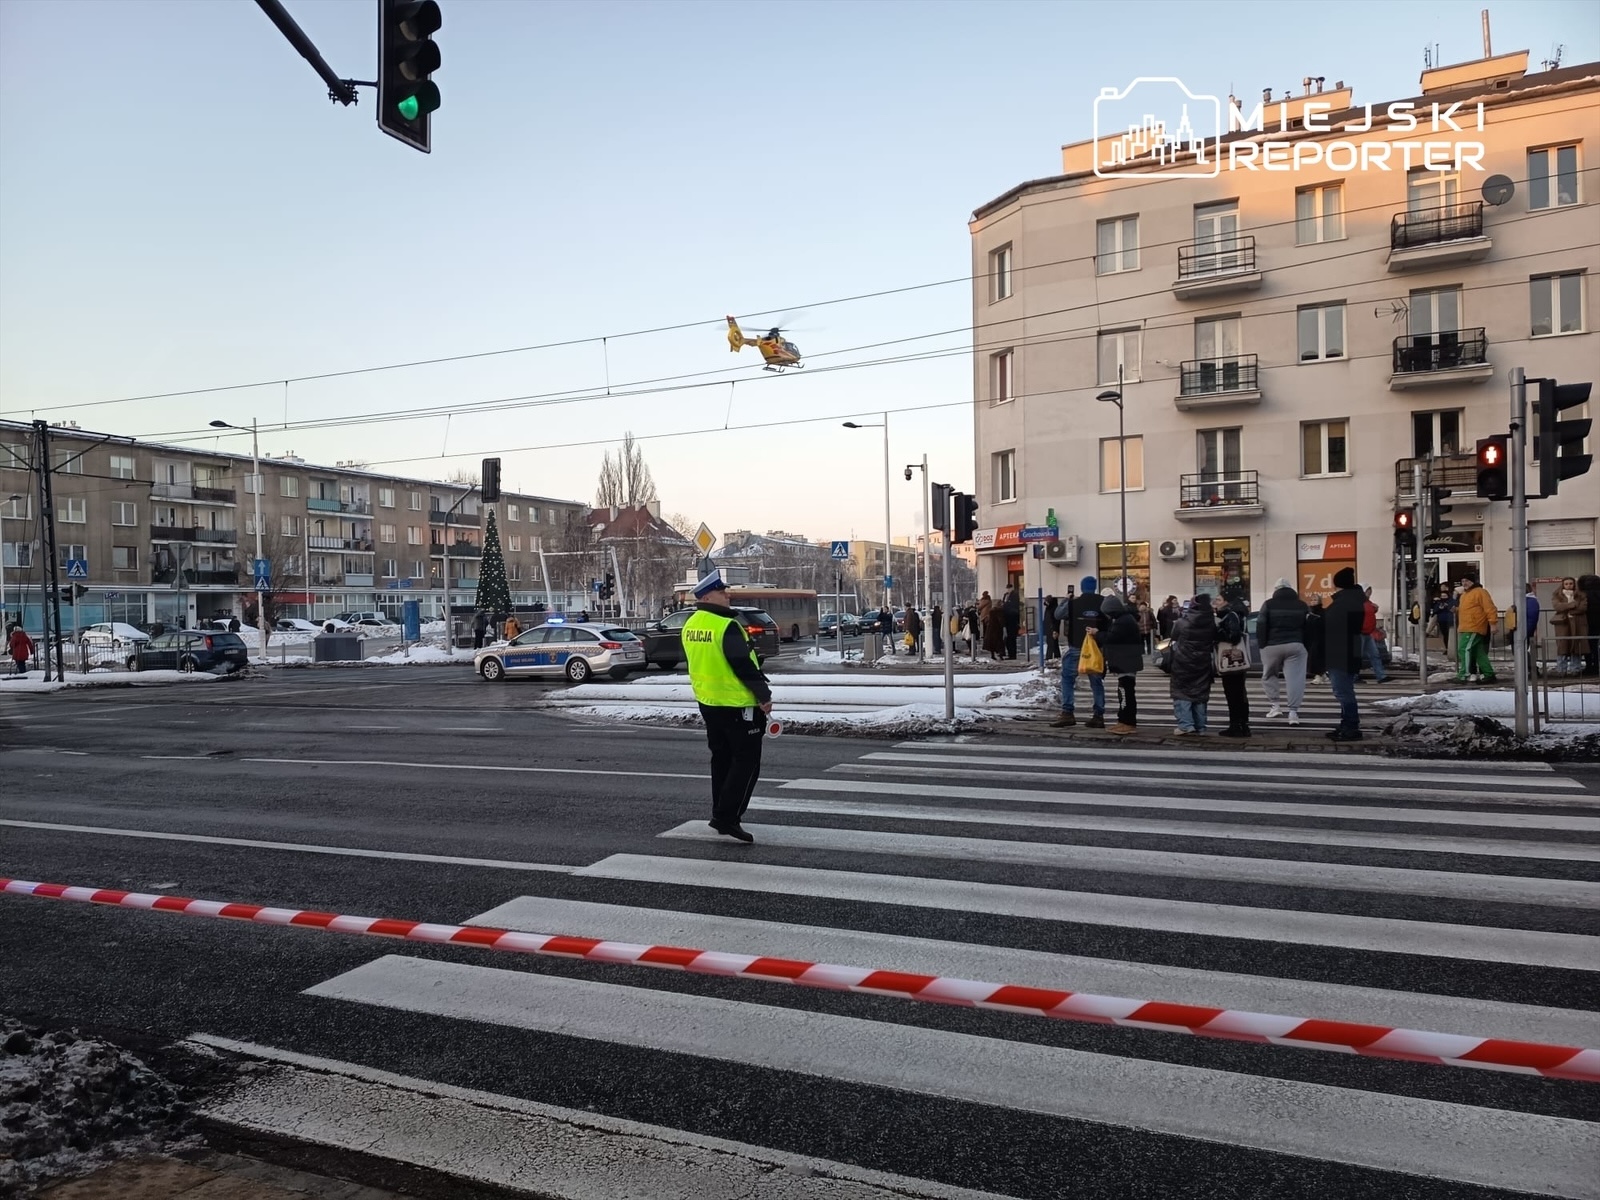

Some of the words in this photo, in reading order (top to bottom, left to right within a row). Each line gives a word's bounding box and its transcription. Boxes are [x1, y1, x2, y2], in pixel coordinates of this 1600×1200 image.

[1022, 530, 1055, 538] Grochowska
[1303, 574, 1316, 590] 7
[1320, 573, 1332, 589] d
[685, 629, 713, 643] POLICJA
